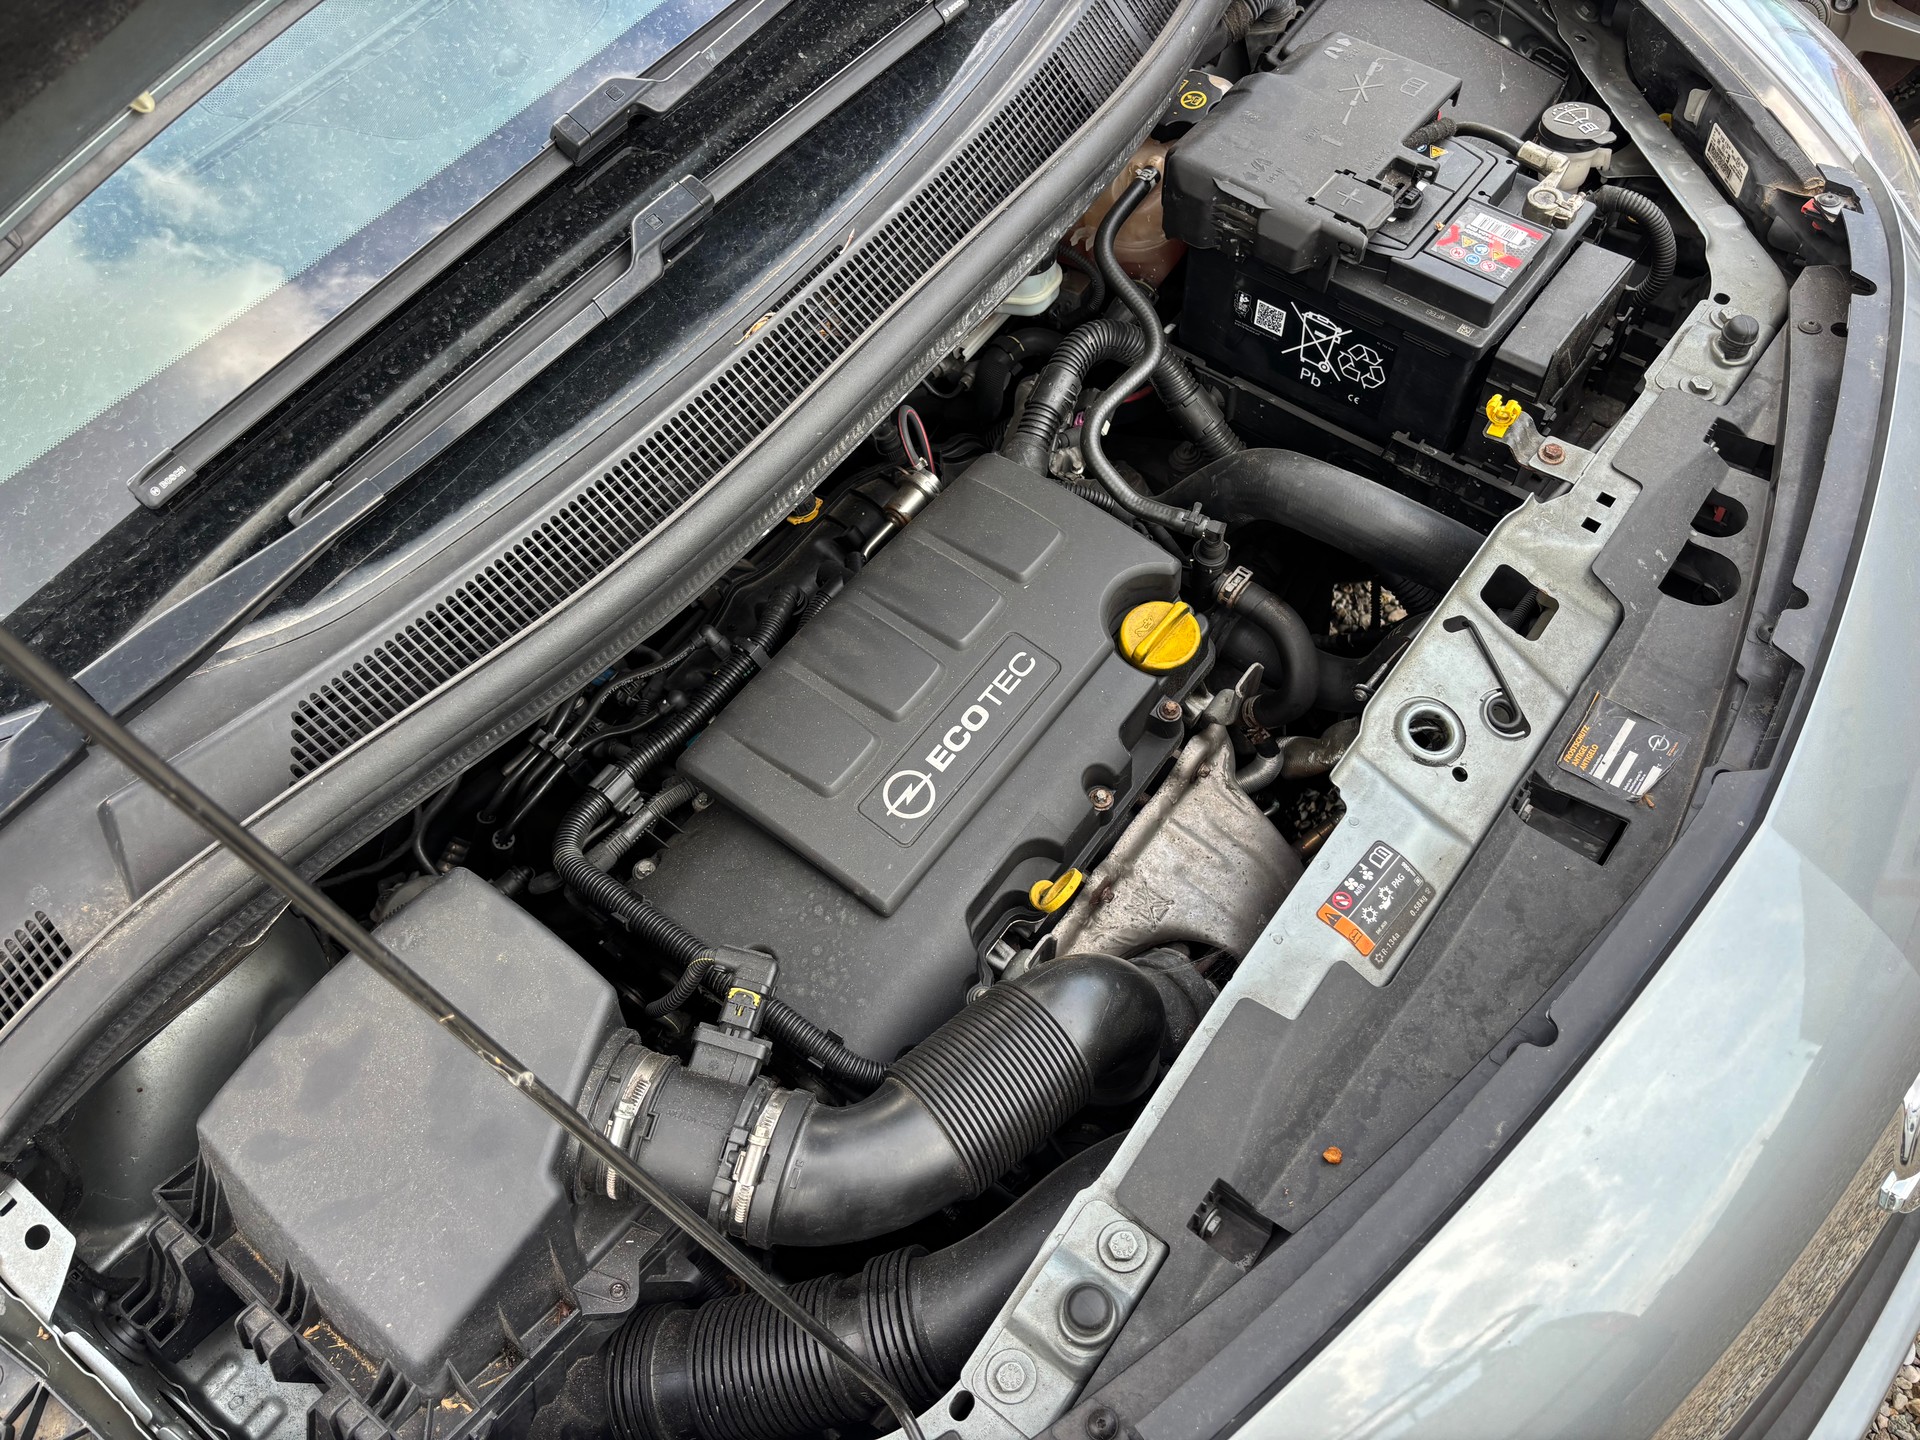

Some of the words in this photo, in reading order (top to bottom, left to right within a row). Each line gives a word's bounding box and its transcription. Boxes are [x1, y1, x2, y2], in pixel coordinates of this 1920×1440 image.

[1300, 367, 1321, 387] Pb
[1347, 394, 1360, 404] CE
[158, 465, 187, 489] BOSCH
[924, 651, 1036, 773] ECOTEC
[1563, 724, 1590, 763] FROSTSCHUTZ
[1571, 744, 1589, 767] ANTIGEL
[1580, 743, 1599, 771] ANTIGELO
[1353, 883, 1366, 896] AUTO
[1391, 873, 1405, 888] PAG
[1381, 932, 1400, 956] R-134a
